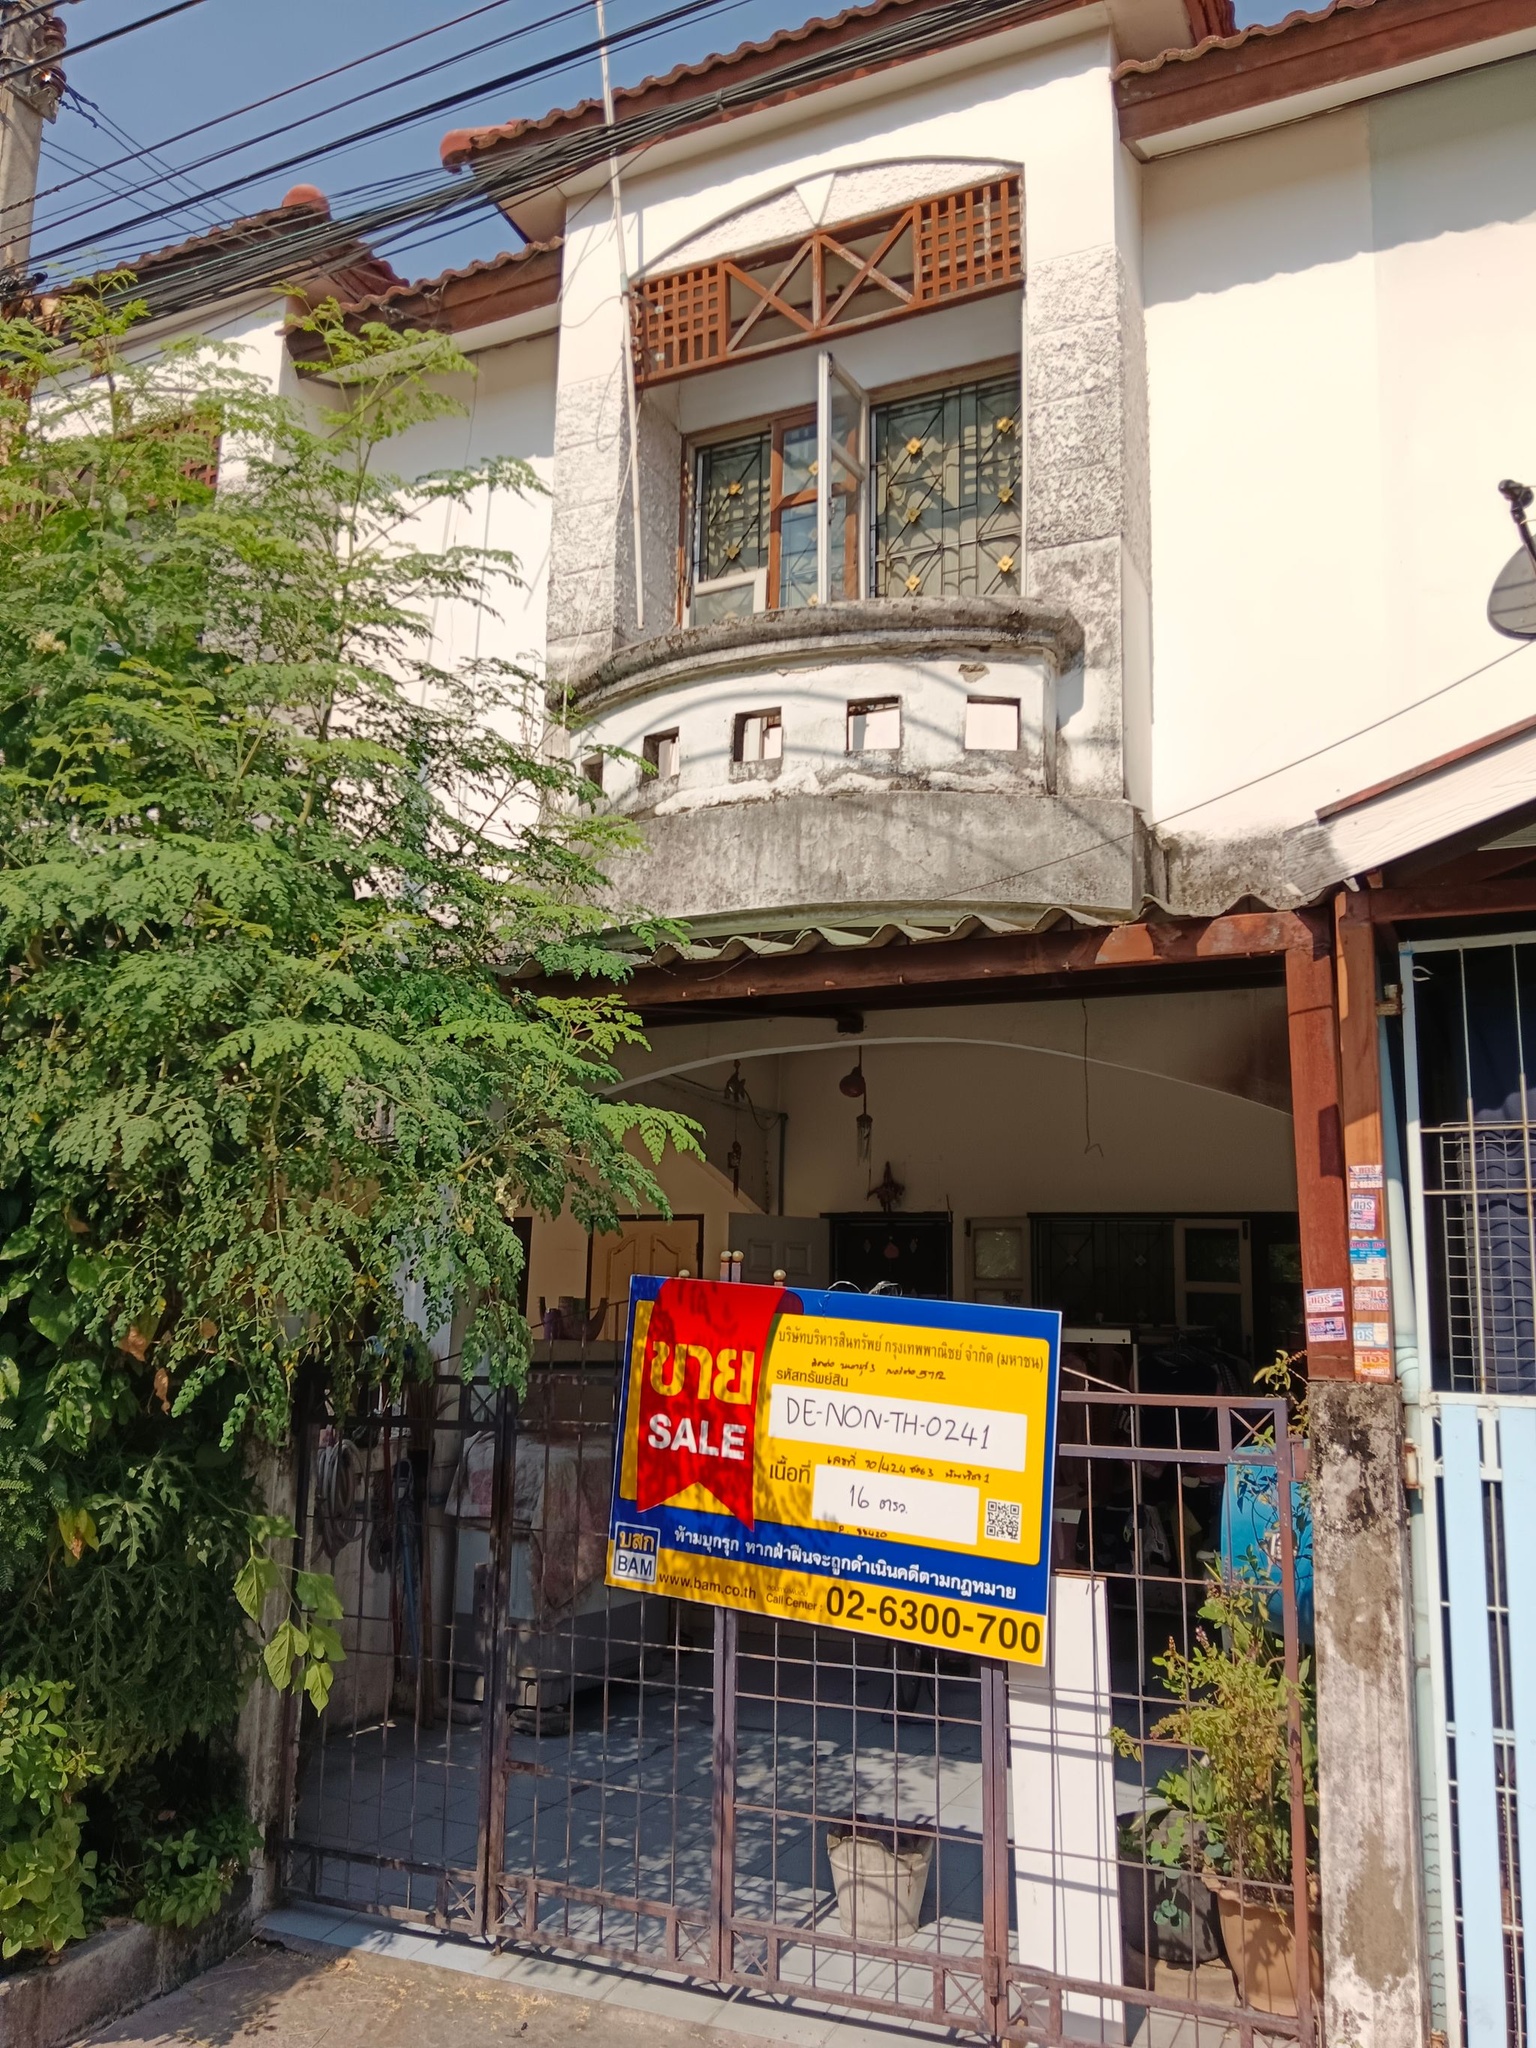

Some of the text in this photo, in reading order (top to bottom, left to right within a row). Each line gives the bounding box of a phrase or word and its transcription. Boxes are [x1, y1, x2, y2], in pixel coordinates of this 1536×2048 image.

[778, 1326, 1044, 1372] บริษัทบริหารสินทรัพย์ กรุงเทพพาณิชย์ จำกัด (มหาชน)
[650, 1341, 755, 1405] ขาย
[776, 1367, 849, 1388] รหัสทรัพย์สิน
[648, 1413, 746, 1460] SALE
[787, 1396, 990, 1450] DE-NON-TH-0241
[769, 1455, 811, 1485] เนื้อที่
[849, 1484, 870, 1508] 16
[619, 1530, 654, 1552] บสก
[617, 1556, 653, 1577] BAM
[674, 1525, 1017, 1600] ห้ามบุกรุก หากฝ่าฝืนจะถูกดำเนินคดีตามกฎหมาย
[659, 1573, 757, 1600] www.bam.co.th
[766, 1592, 784, 1605] Call
[785, 1596, 817, 1611] Center
[826, 1586, 1041, 1654] 02-6300-700
